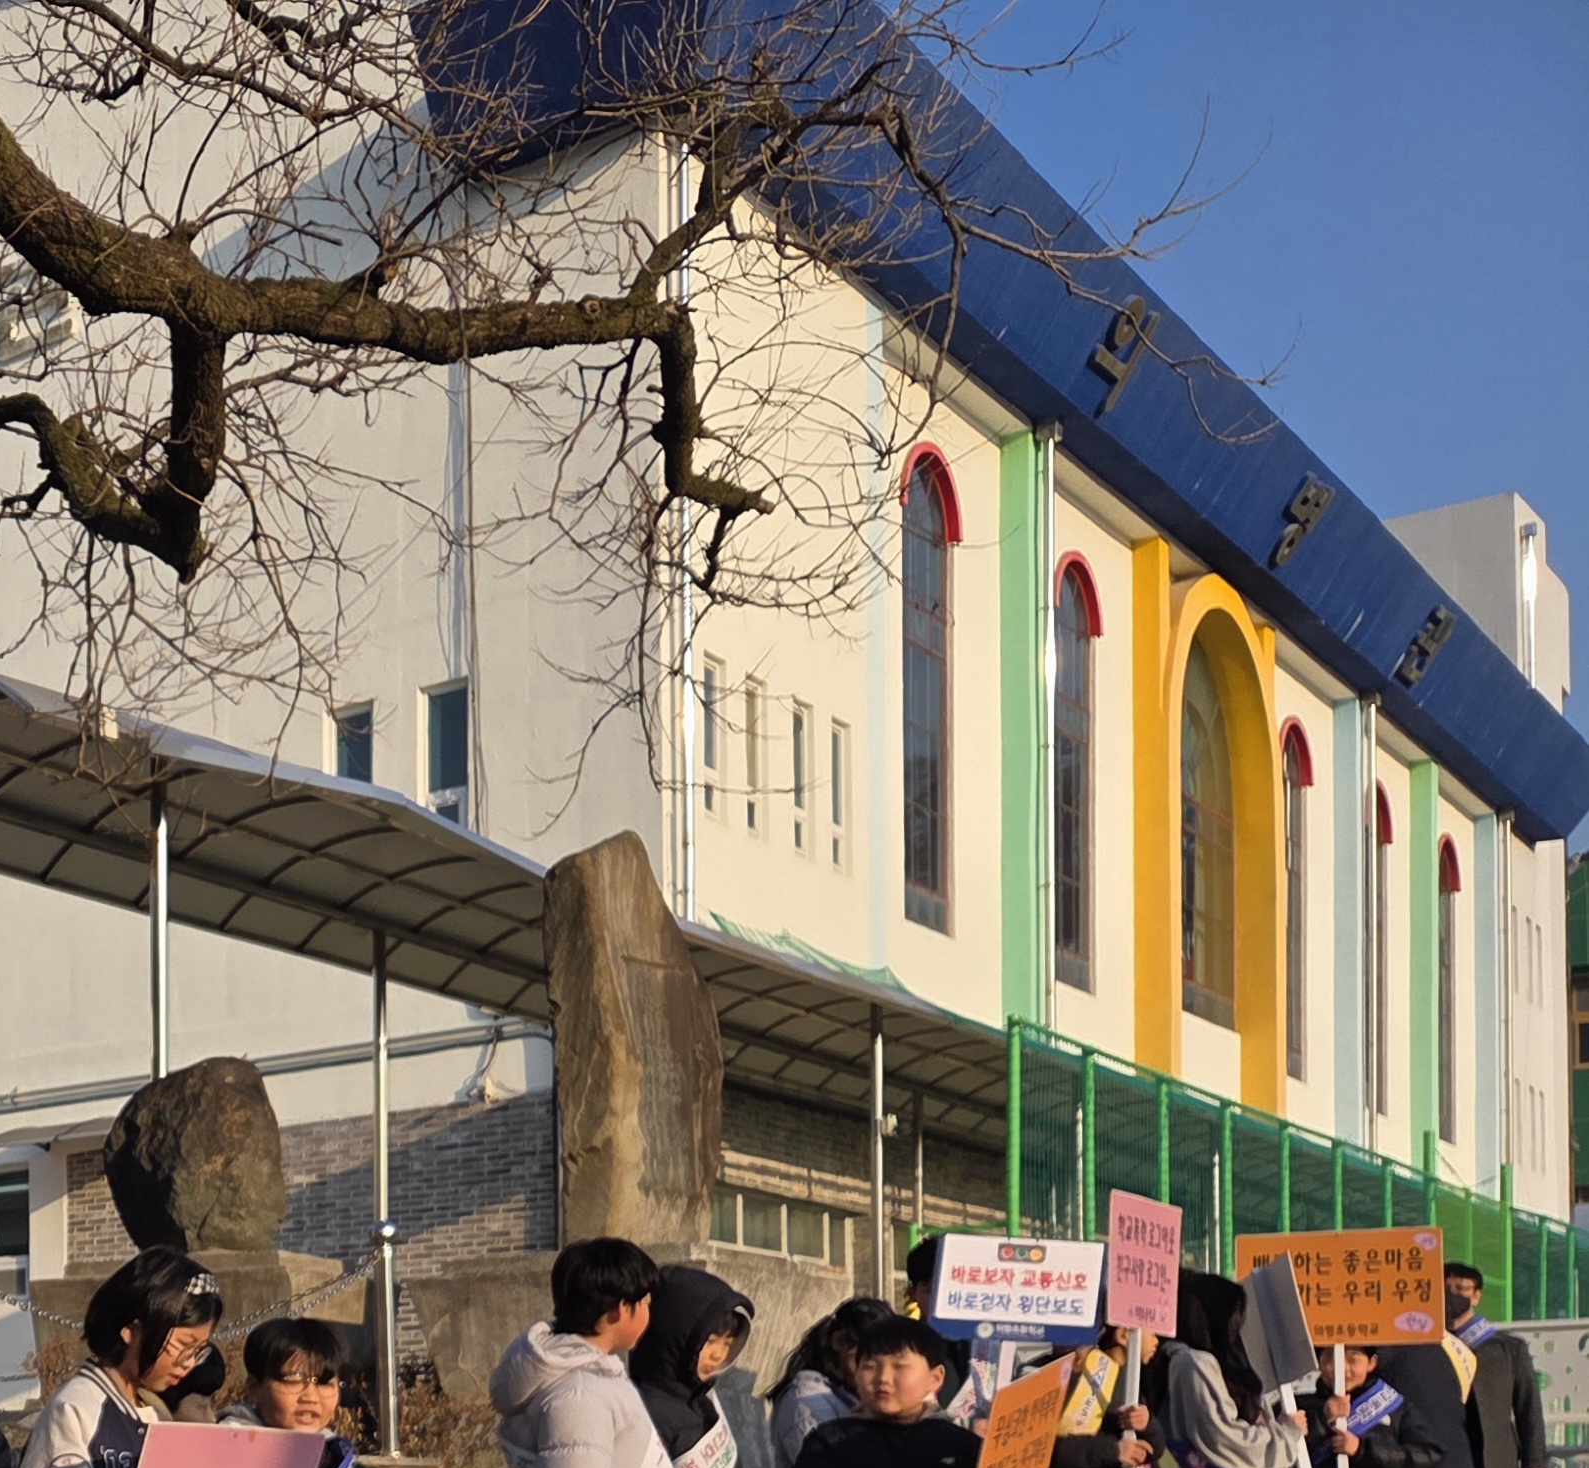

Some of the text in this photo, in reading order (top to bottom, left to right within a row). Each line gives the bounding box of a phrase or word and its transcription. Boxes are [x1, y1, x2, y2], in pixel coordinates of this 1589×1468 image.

[1253, 1246, 1425, 1276] 배하는 좋은마음
[951, 1264, 1088, 1291] 바로보자 교통신호
[947, 1290, 1085, 1315] 바로걷자 횡단보도
[1298, 1278, 1433, 1306] 가는 우리 우정
